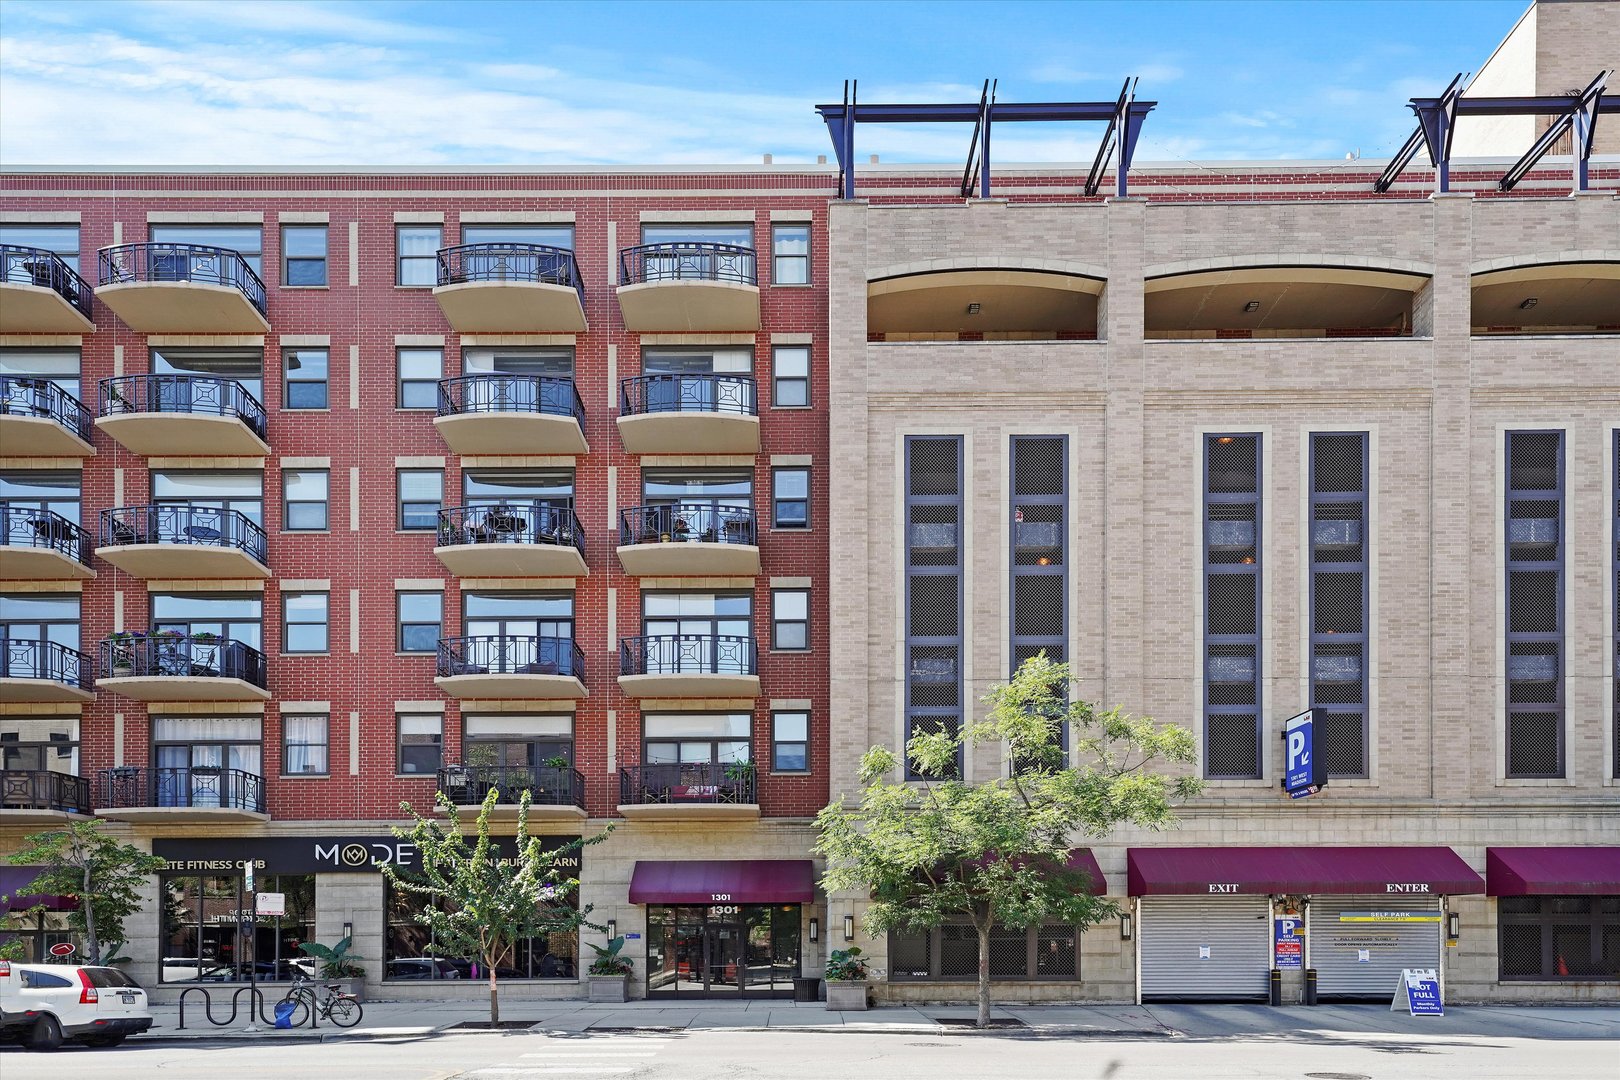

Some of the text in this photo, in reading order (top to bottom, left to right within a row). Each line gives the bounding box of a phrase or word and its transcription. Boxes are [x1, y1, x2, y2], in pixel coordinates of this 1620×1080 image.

[1288, 731, 1304, 771] P
[315, 844, 414, 866] MODE
[156, 861, 184, 870] ITE
[187, 860, 233, 870] FITNESS
[539, 857, 578, 867] EARN
[1208, 883, 1429, 893] EXIT ENTER
[710, 905, 739, 914] 1301
[1282, 920, 1295, 934] P
[1413, 991, 1436, 999] FULL
